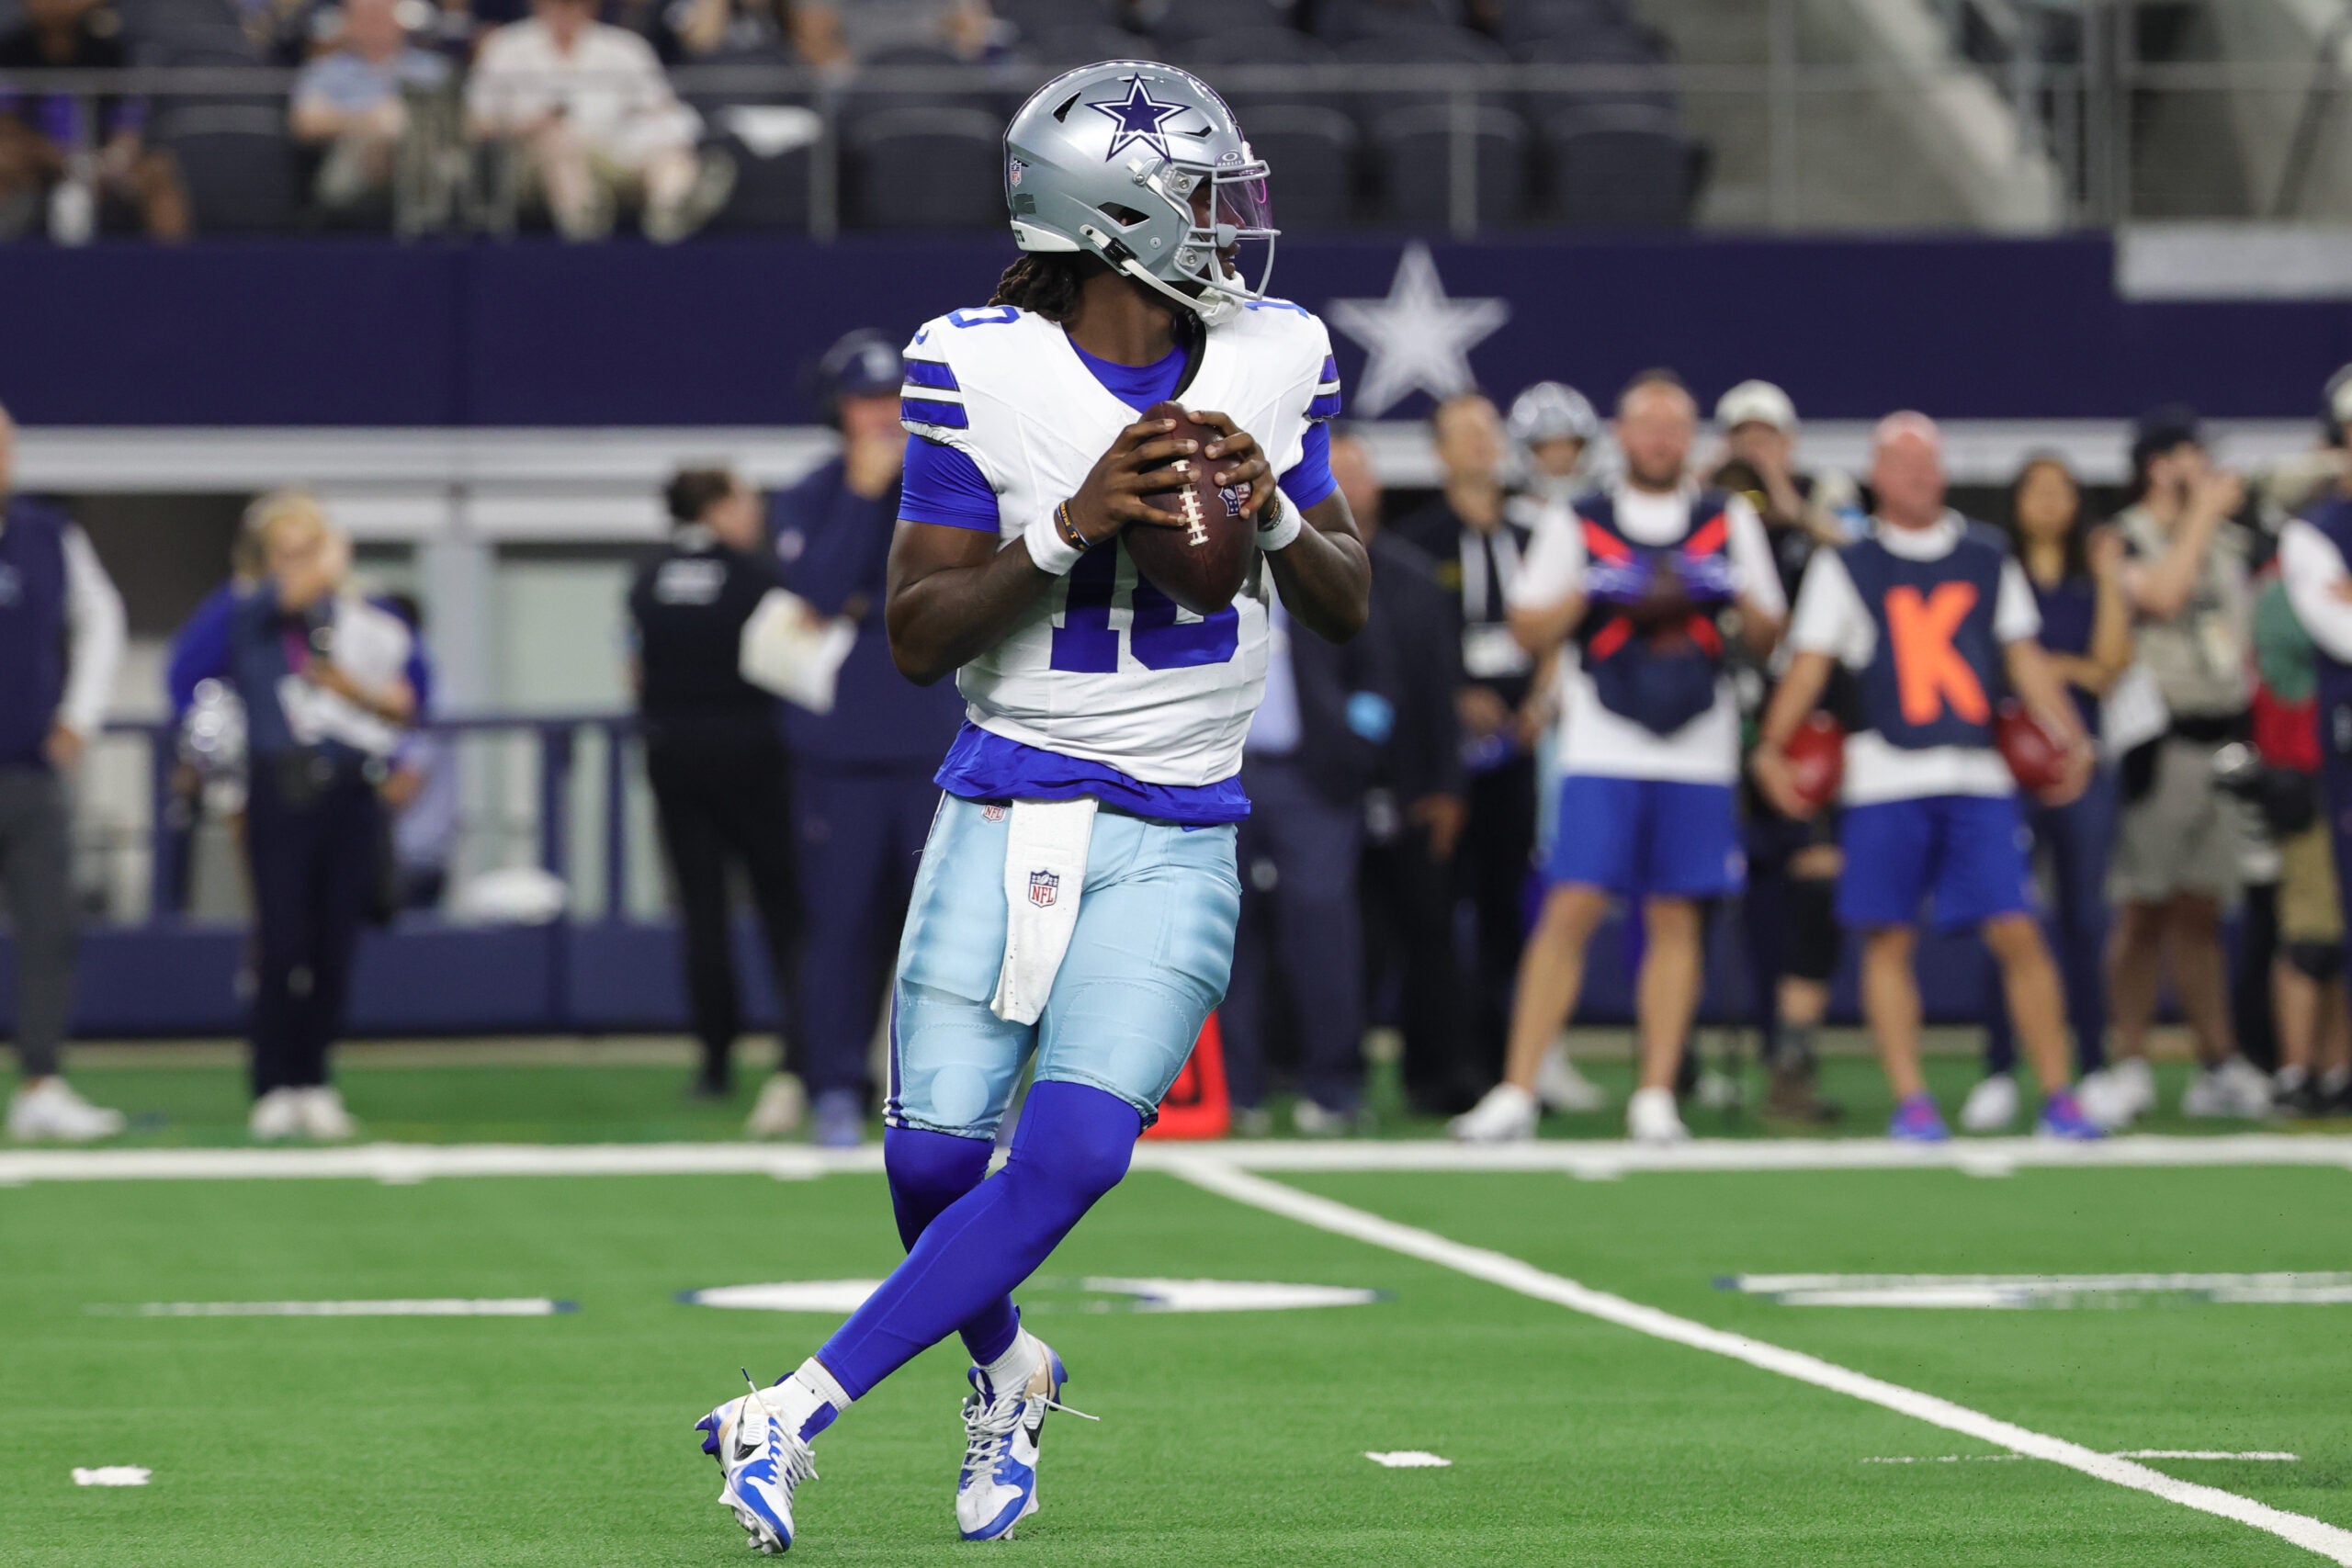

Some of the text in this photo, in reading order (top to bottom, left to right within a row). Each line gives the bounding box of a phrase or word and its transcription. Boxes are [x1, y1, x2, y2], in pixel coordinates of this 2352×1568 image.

[1884, 581, 1991, 727] K
[985, 806, 1001, 818] NFL
[1031, 885, 1055, 904] NFL
